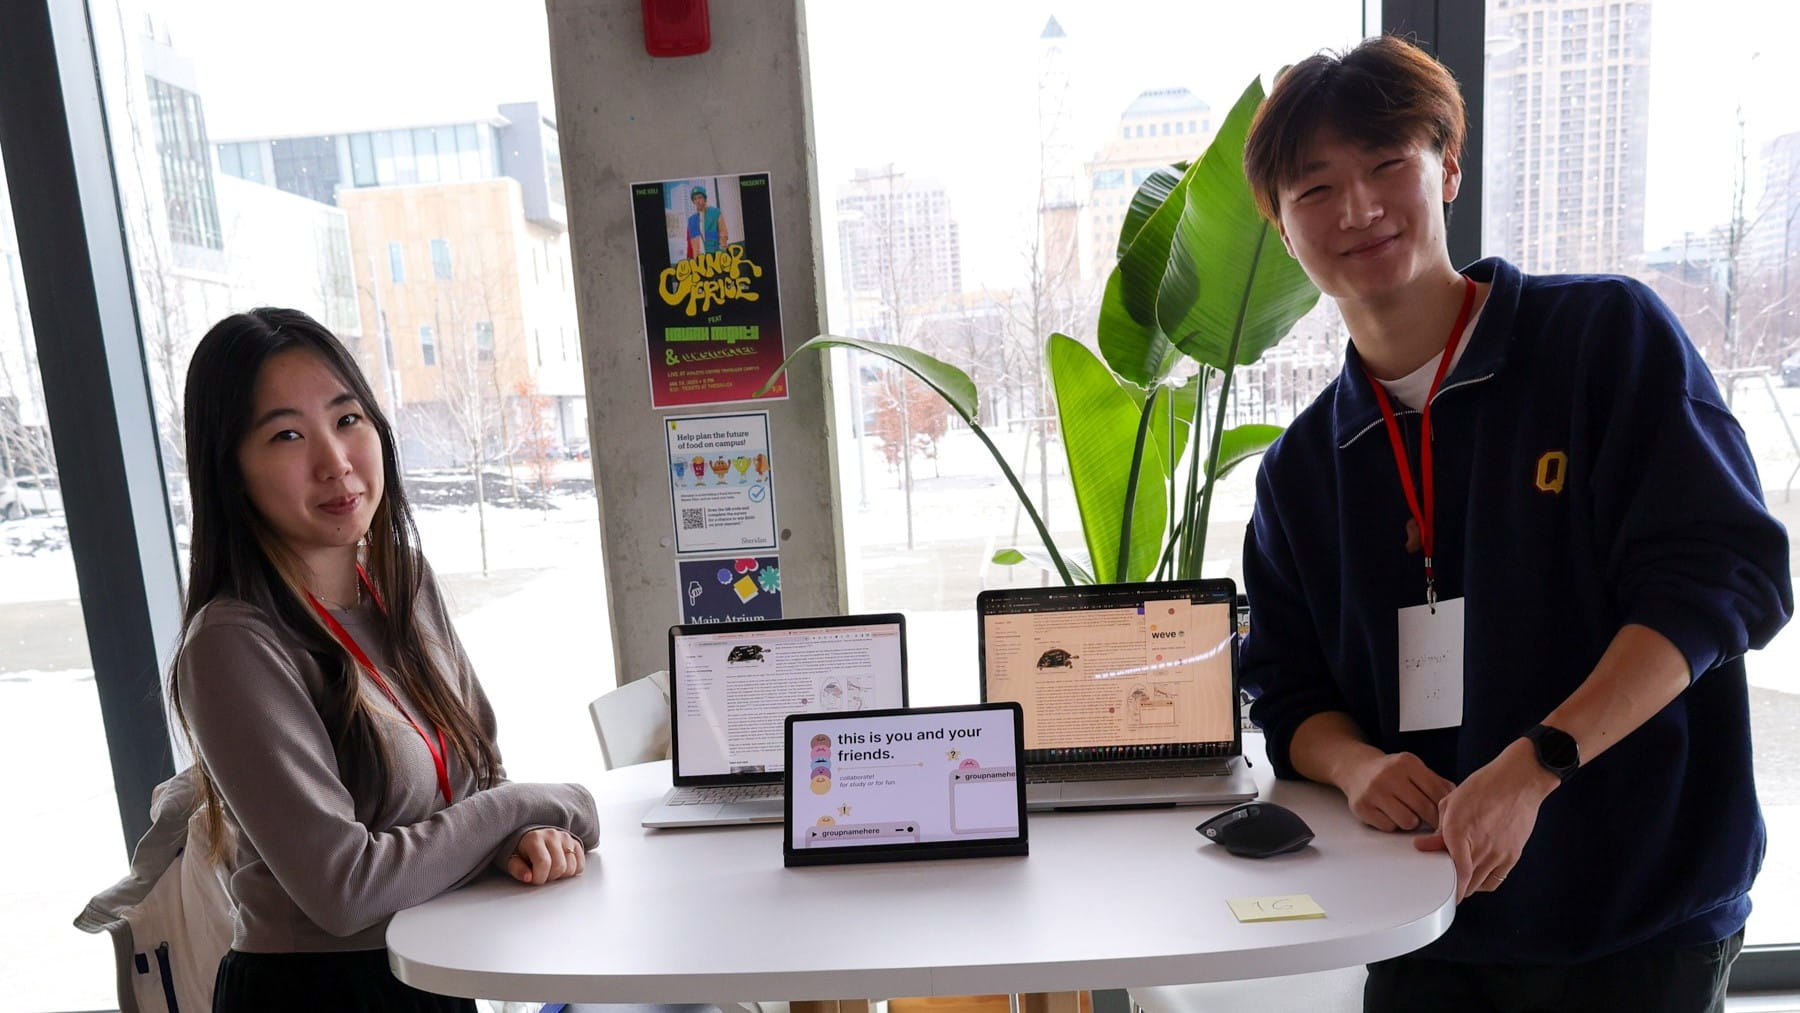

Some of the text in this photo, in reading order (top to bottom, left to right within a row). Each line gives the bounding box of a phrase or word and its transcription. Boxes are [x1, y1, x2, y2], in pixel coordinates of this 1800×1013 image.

[659, 245, 762, 305] CONNOR
[686, 277, 759, 316] PRICE
[707, 315, 722, 323] FEAT
[677, 433, 694, 441] Help
[696, 433, 712, 441] plan
[713, 431, 725, 439] the
[686, 441, 703, 449] food
[715, 439, 746, 448] campus!
[1536, 451, 1568, 493] Q
[691, 614, 765, 624] Main Atrium
[1151, 631, 1177, 639] weve
[838, 728, 982, 745] this is you and your
[838, 749, 895, 761] friends.
[822, 828, 880, 838] groupnamehere
